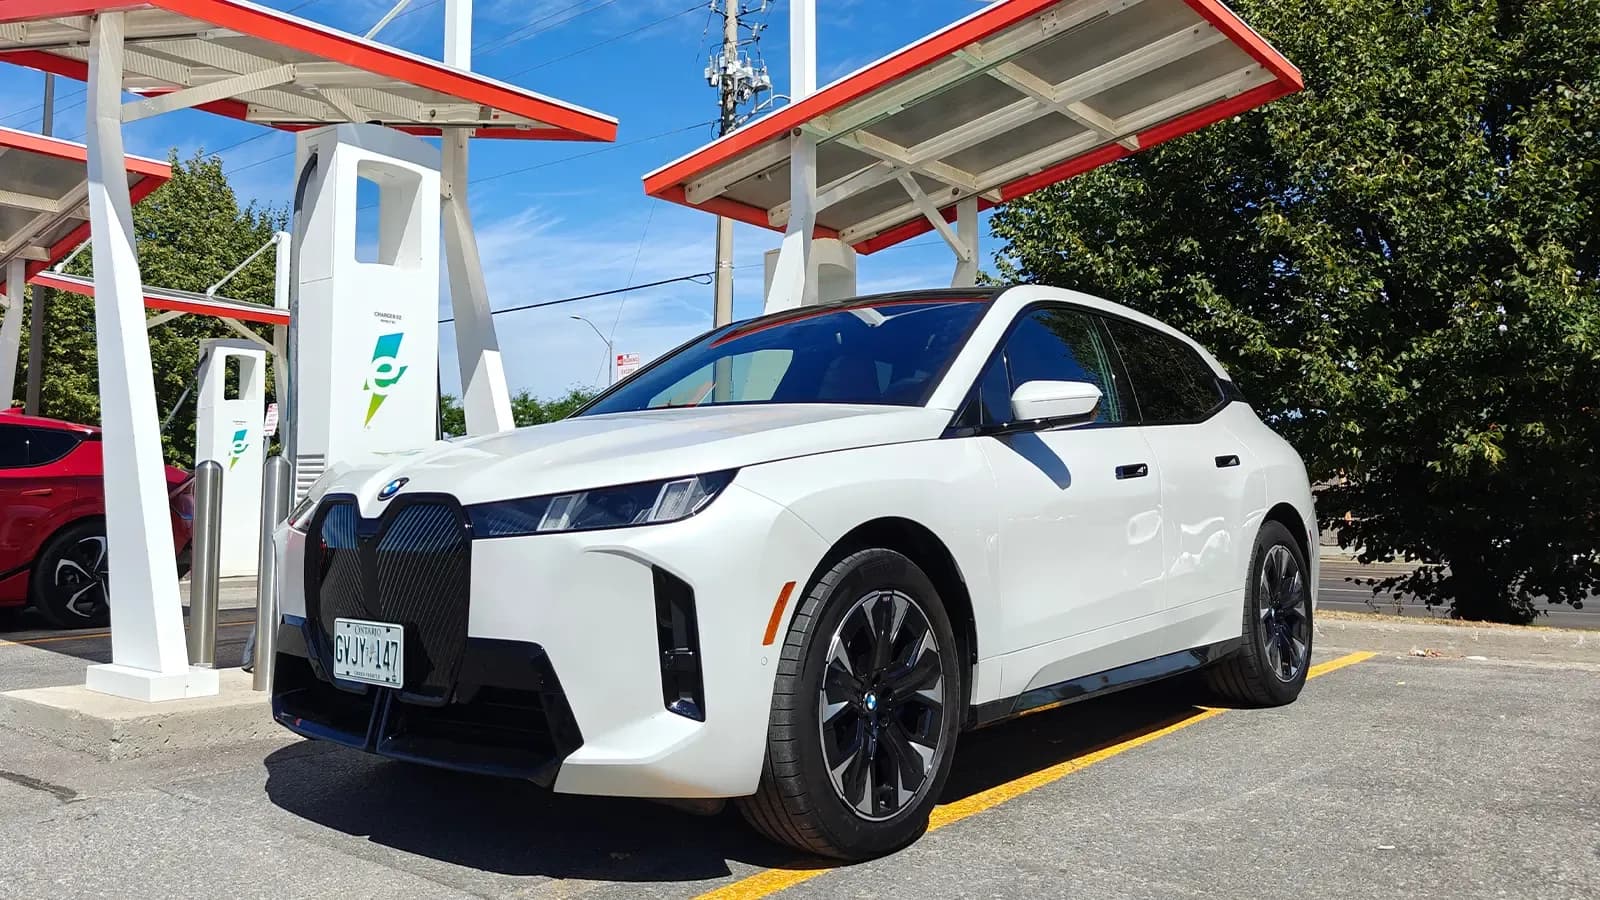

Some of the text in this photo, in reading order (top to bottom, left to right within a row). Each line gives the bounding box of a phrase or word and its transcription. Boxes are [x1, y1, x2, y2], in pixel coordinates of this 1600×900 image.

[354, 625, 382, 637] ONTARIO
[335, 635, 399, 671] GVJY 147
